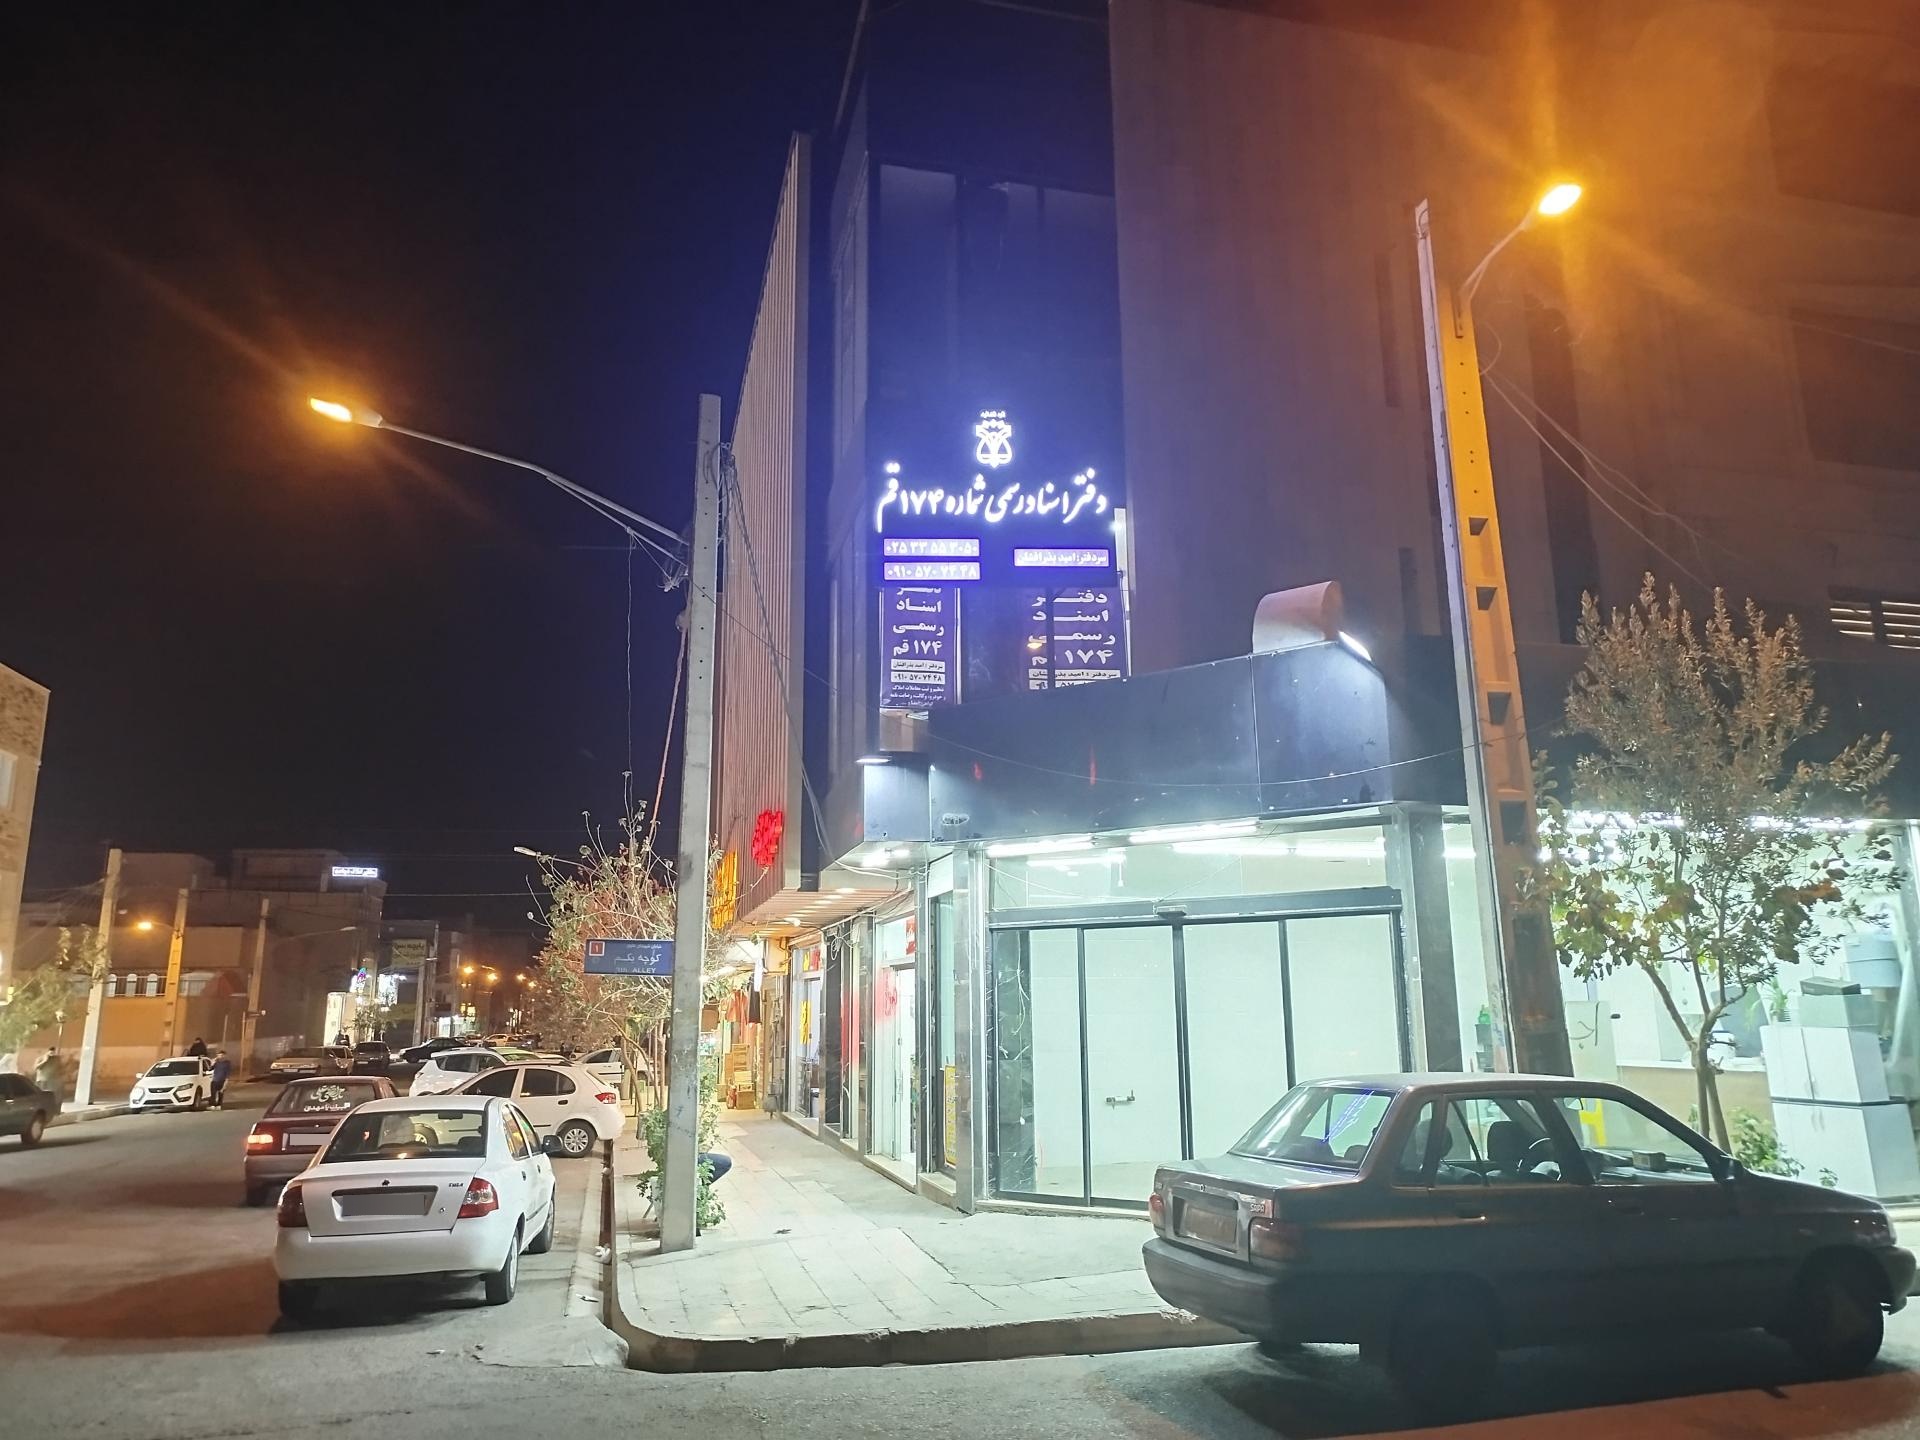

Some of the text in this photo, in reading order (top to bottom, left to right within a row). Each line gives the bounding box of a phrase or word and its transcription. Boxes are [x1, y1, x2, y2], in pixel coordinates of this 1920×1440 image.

[877, 462, 1107, 533] دفتر اسناد رسمی شماره ۱۷۴ قم
[896, 597, 942, 613] اسناد
[1032, 609, 1109, 622] اسند
[892, 622, 945, 637] رسمی
[893, 639, 943, 657] ۱۷۴ قم
[1064, 649, 1114, 664] ۱۷۴
